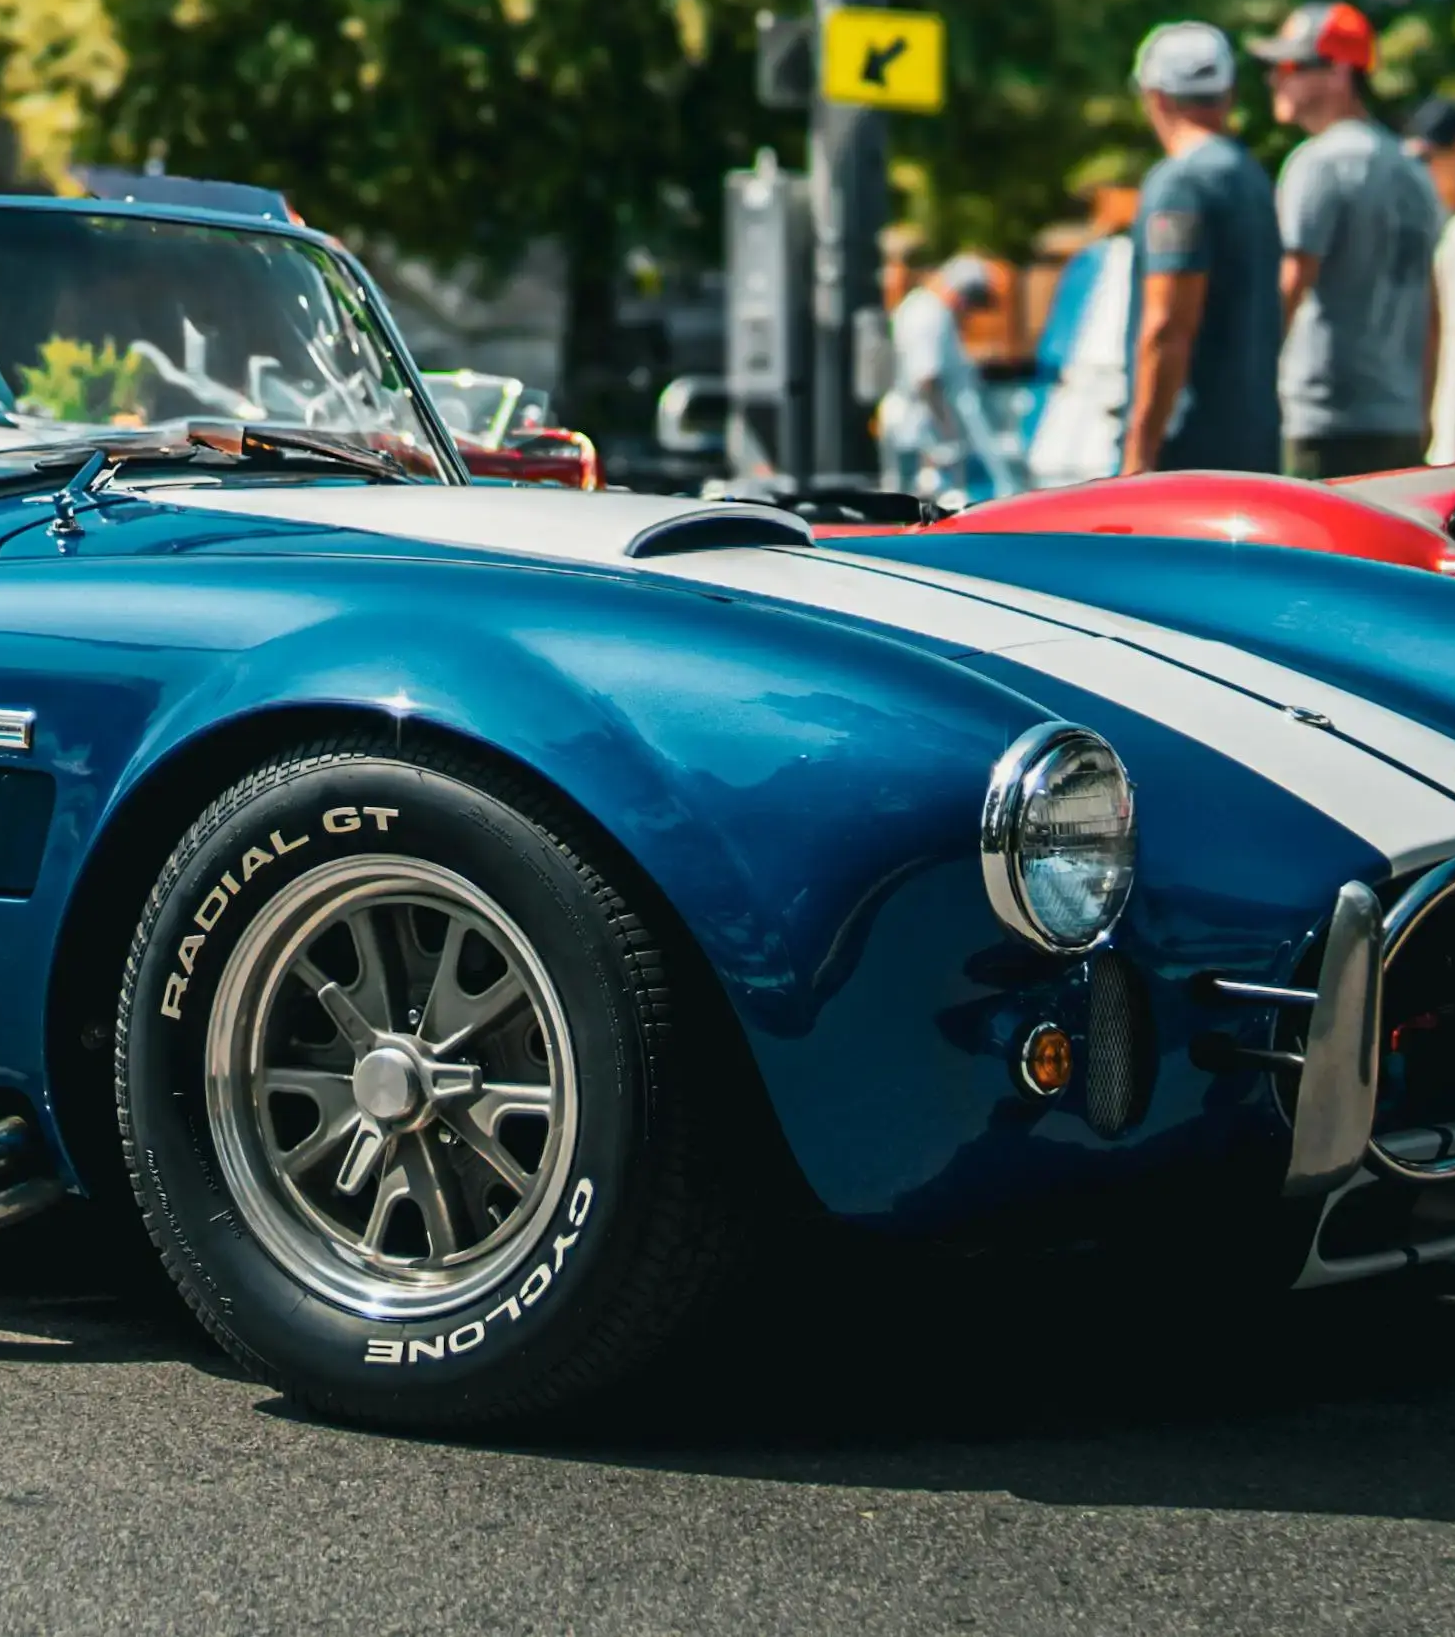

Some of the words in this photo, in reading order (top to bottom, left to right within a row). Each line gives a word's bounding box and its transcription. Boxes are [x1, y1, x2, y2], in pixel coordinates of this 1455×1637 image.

[160, 829, 311, 1021] RADIAL
[321, 806, 400, 834] GT
[363, 1177, 595, 1364] CYCLONE
